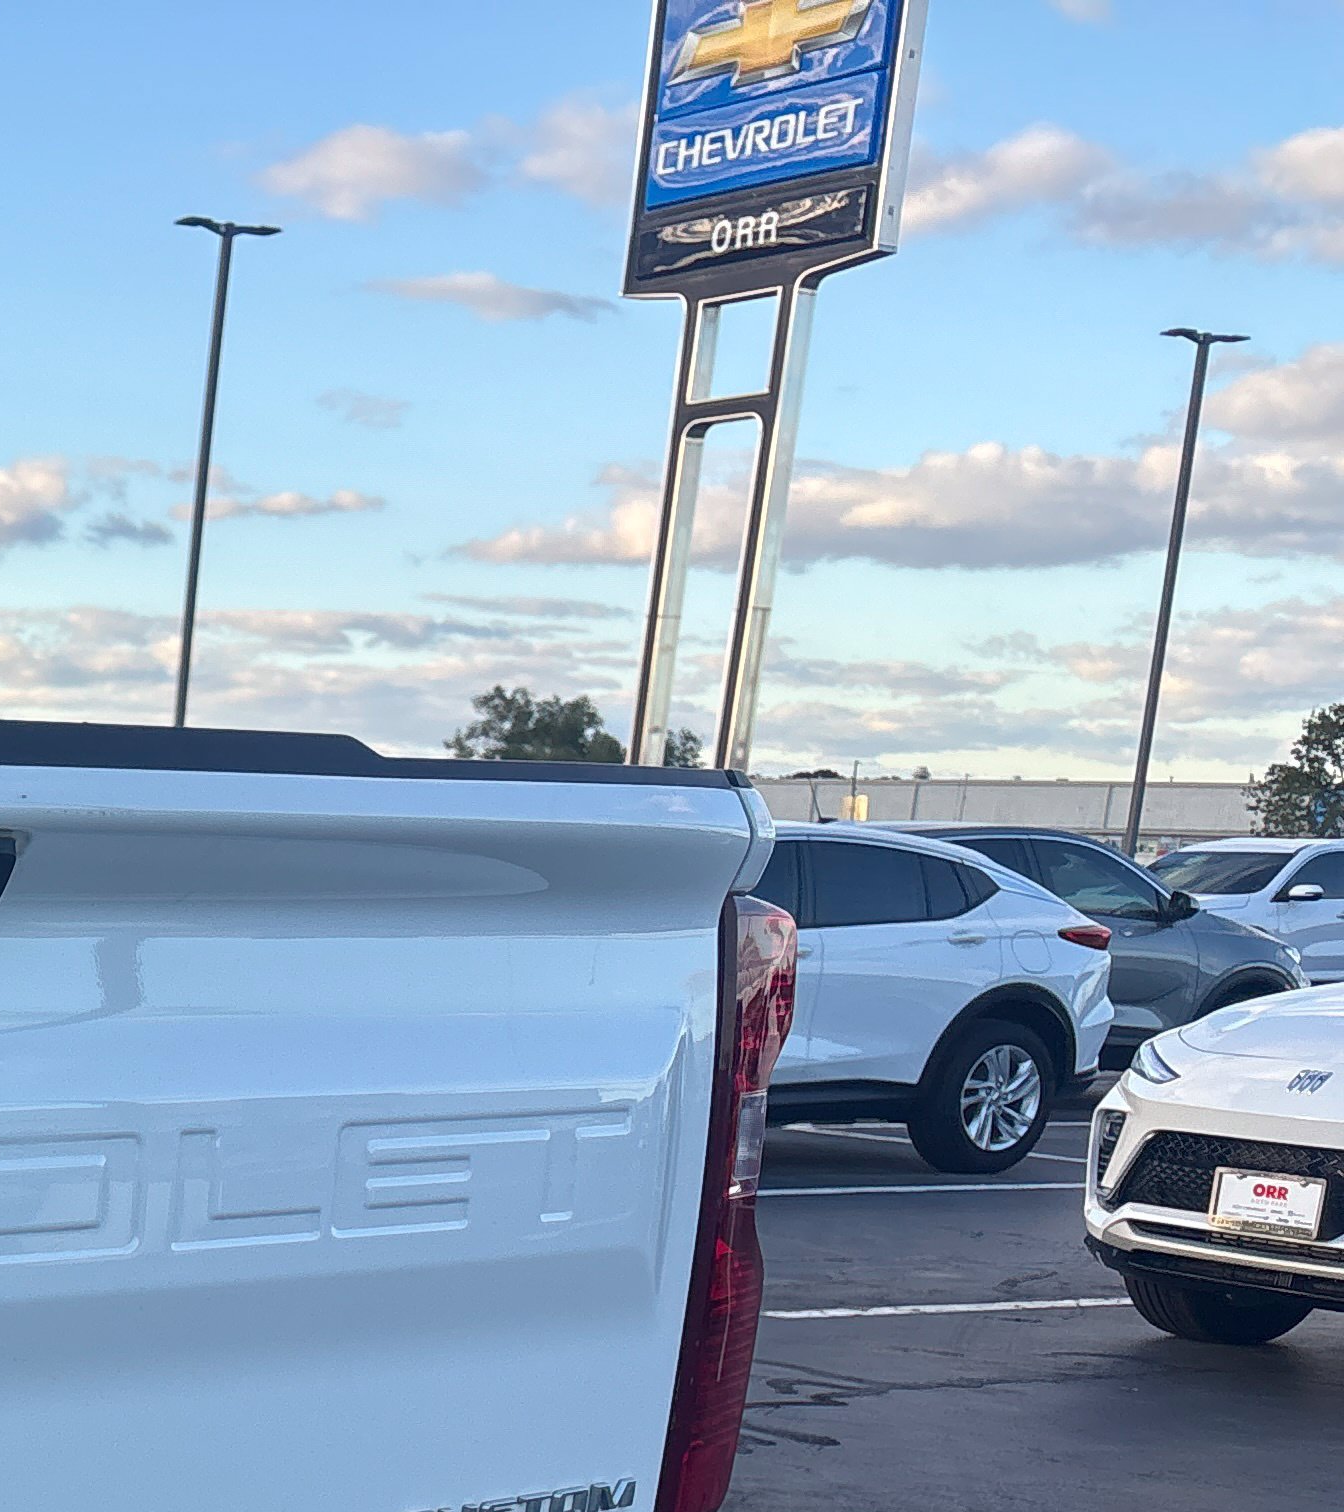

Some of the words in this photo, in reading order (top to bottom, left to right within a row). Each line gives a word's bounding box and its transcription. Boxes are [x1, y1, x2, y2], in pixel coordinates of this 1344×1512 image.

[655, 98, 864, 175] CHEVROLET
[711, 210, 779, 253] ORR
[1252, 1183, 1289, 1200] ORR
